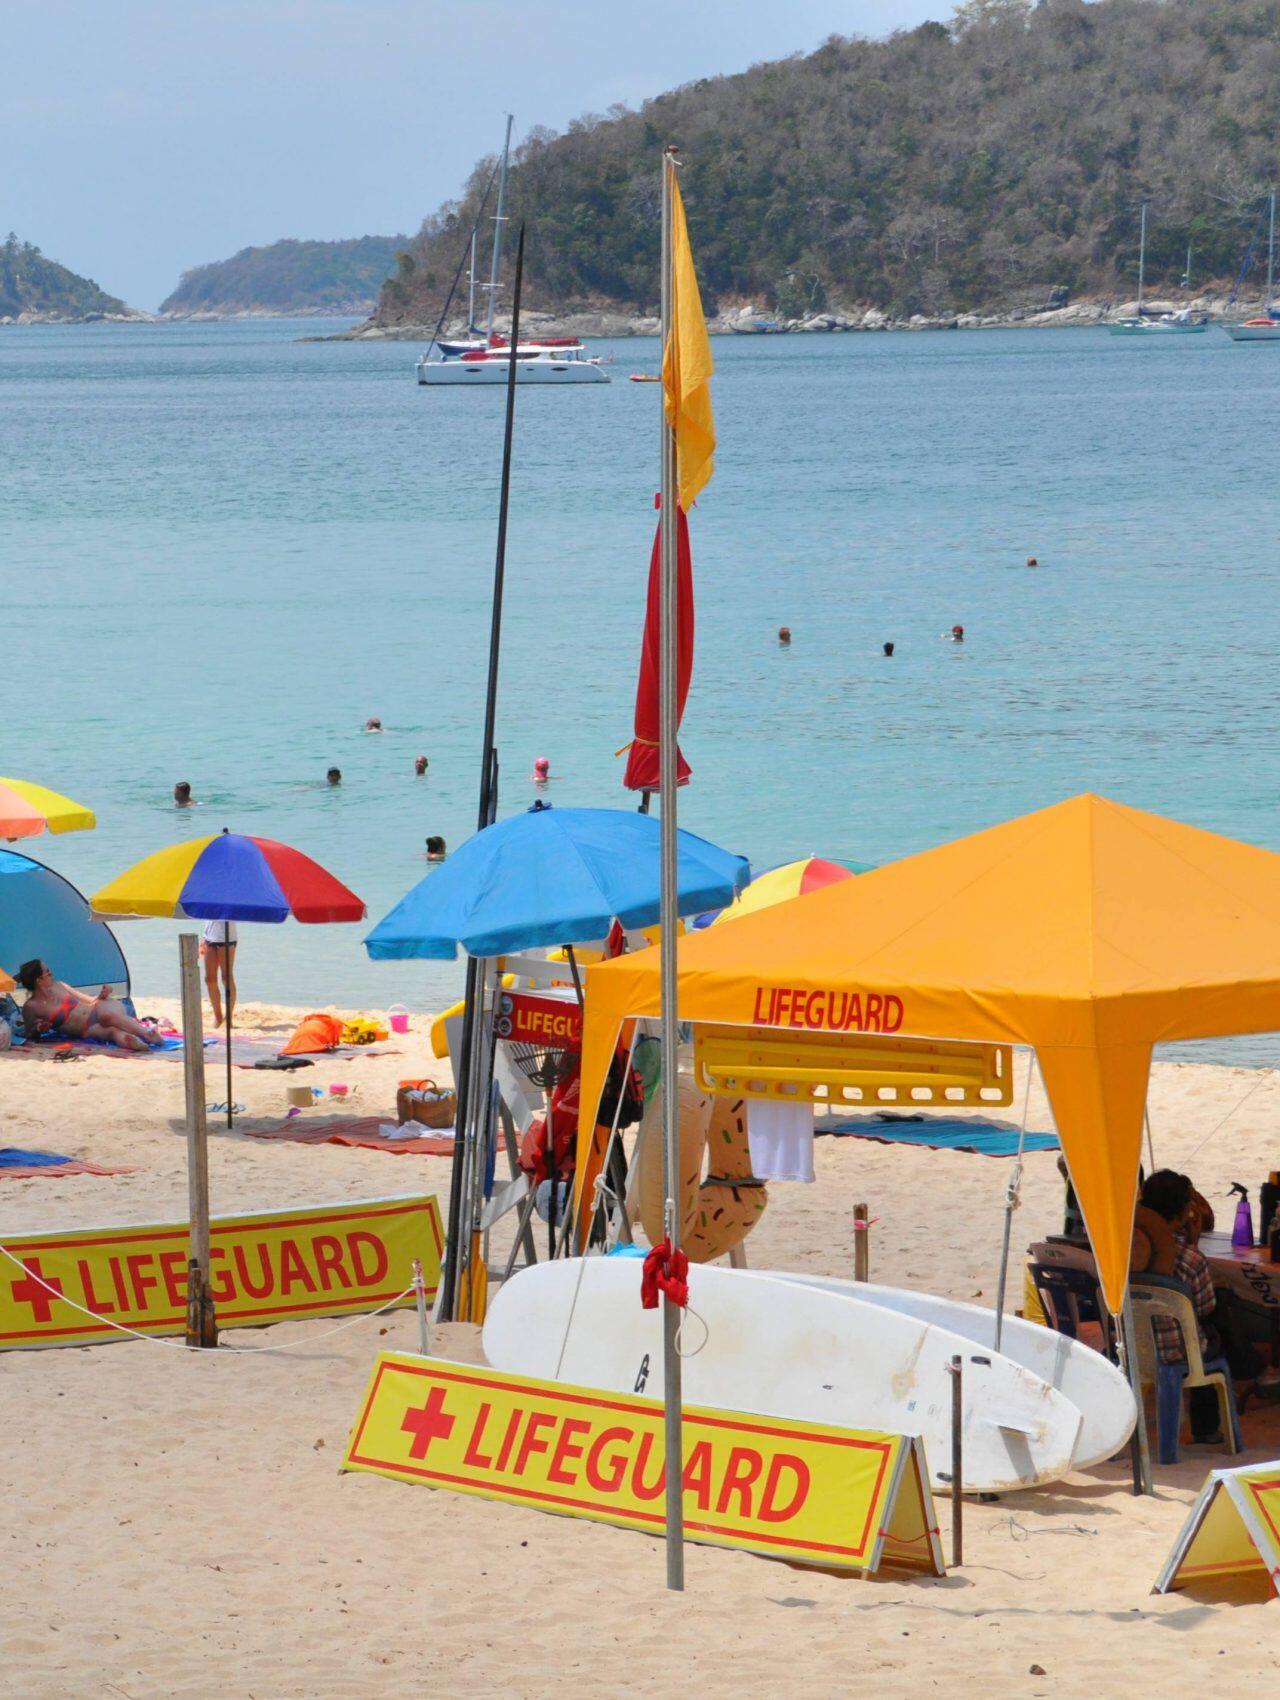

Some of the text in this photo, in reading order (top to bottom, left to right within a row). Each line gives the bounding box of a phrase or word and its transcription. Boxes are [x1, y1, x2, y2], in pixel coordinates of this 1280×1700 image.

[753, 987, 904, 1034] LIFEGUARD
[78, 1232, 388, 1314] LIFEGUARD
[463, 1403, 811, 1523] LIFEGUARD
